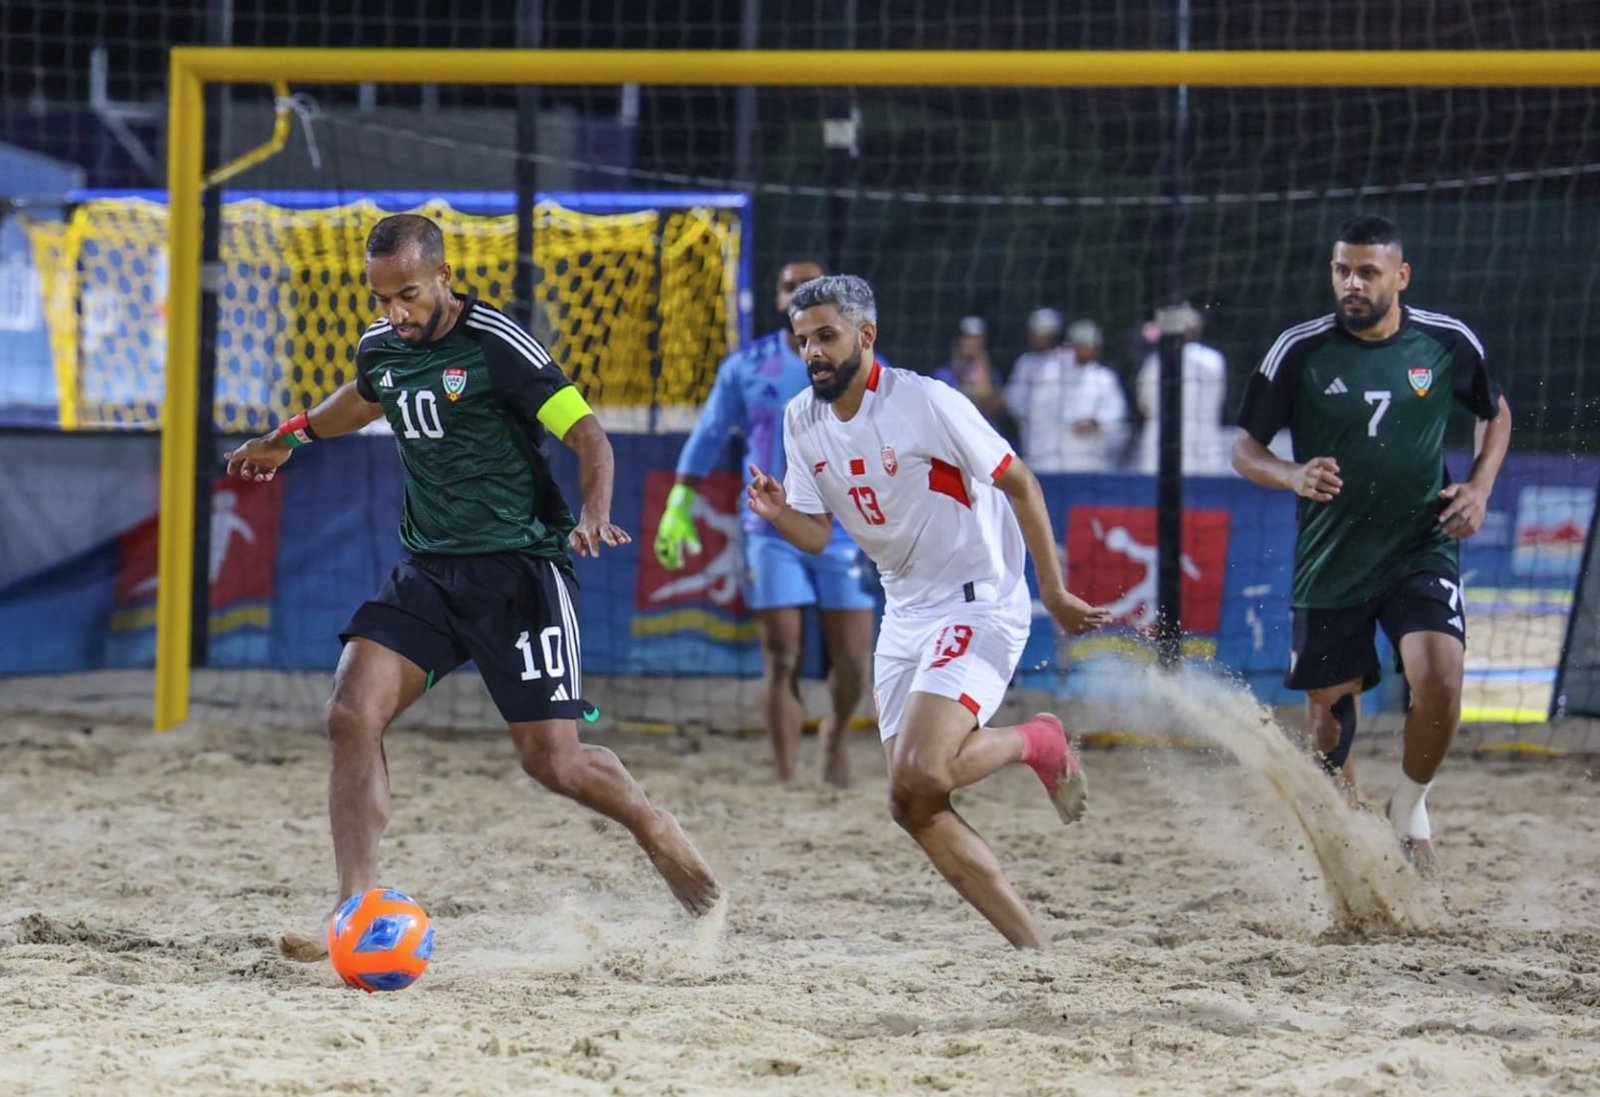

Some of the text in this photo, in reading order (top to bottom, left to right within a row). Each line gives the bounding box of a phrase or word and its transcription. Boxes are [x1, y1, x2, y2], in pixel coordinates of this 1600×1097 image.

[396, 389, 445, 439] 10
[1363, 390, 1392, 437] 7
[848, 486, 886, 526] 13
[1438, 577, 1459, 612] 7
[514, 626, 566, 681] 10
